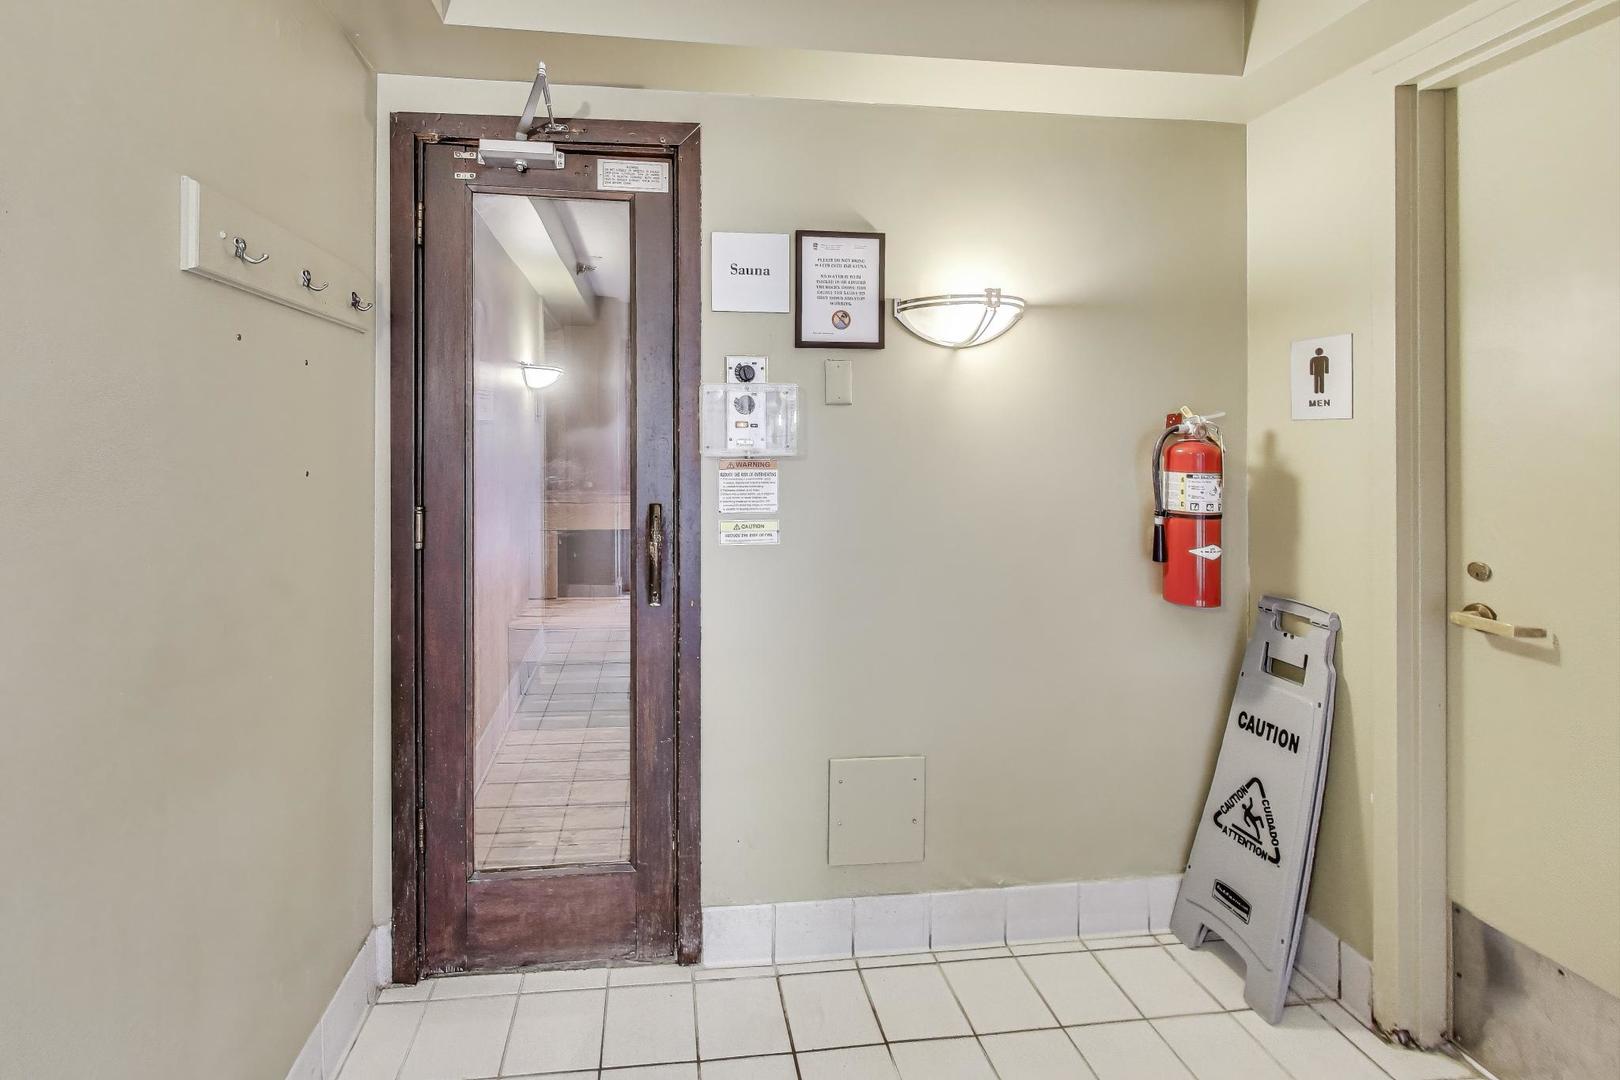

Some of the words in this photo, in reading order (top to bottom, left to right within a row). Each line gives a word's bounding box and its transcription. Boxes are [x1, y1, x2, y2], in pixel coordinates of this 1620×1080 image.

[730, 262, 770, 276] Sauna
[1308, 399, 1330, 407] MEN
[1237, 711, 1300, 755] CAUTION
[1220, 784, 1249, 815] CAUTION
[1261, 798, 1280, 847] CUIDADO
[1221, 826, 1268, 862] ATTENTION
